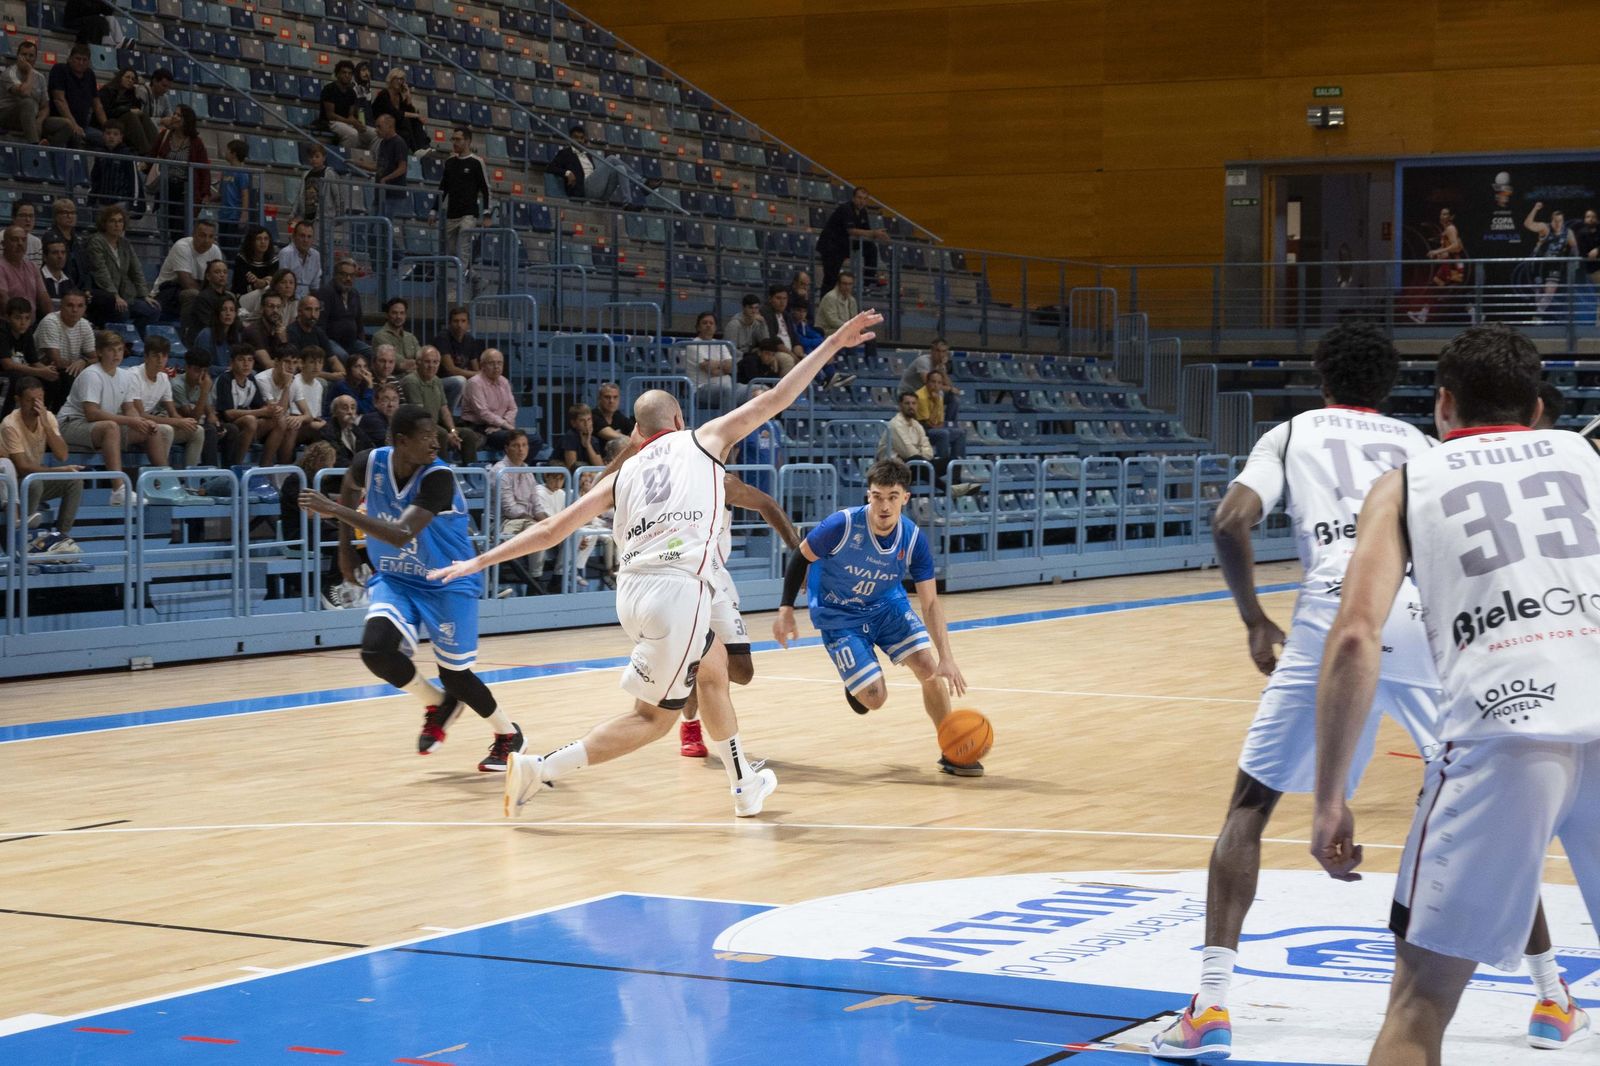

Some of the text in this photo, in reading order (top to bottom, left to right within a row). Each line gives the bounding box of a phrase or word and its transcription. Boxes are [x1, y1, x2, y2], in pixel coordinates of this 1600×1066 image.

[1315, 87, 1340, 96] SALIDA
[1445, 440, 1554, 470] STULIC
[1440, 470, 1600, 577] 33
[852, 580, 876, 596] 40
[734, 618, 748, 635] 3
[1488, 633, 1544, 652] PASSION
[1549, 629, 1574, 640] FOR
[835, 646, 856, 673] 40
[1475, 678, 1556, 711] LOIOLA
[1491, 699, 1543, 719] HOTELA
[852, 884, 1181, 967] HUELVA
